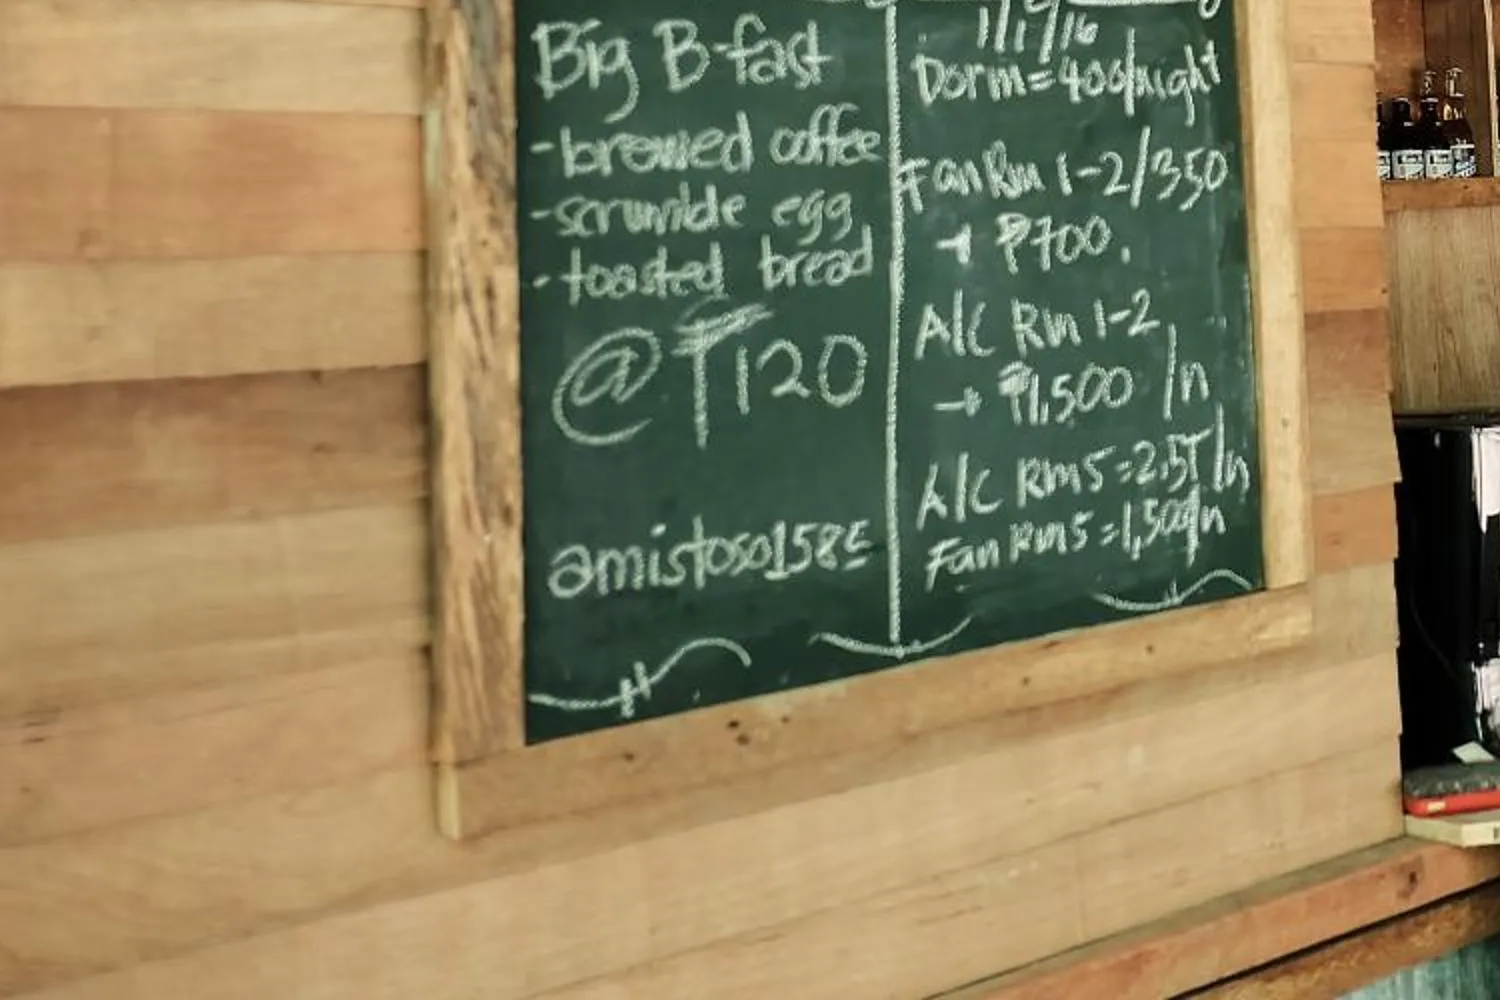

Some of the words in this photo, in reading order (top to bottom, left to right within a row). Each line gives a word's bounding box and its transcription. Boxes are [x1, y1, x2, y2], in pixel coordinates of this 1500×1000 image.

[530, 17, 641, 124] Big
[770, 188, 853, 247] egg
[758, 223, 874, 291] bread
[1010, 298, 1082, 358] Rm
[924, 536, 1001, 593] Fan
